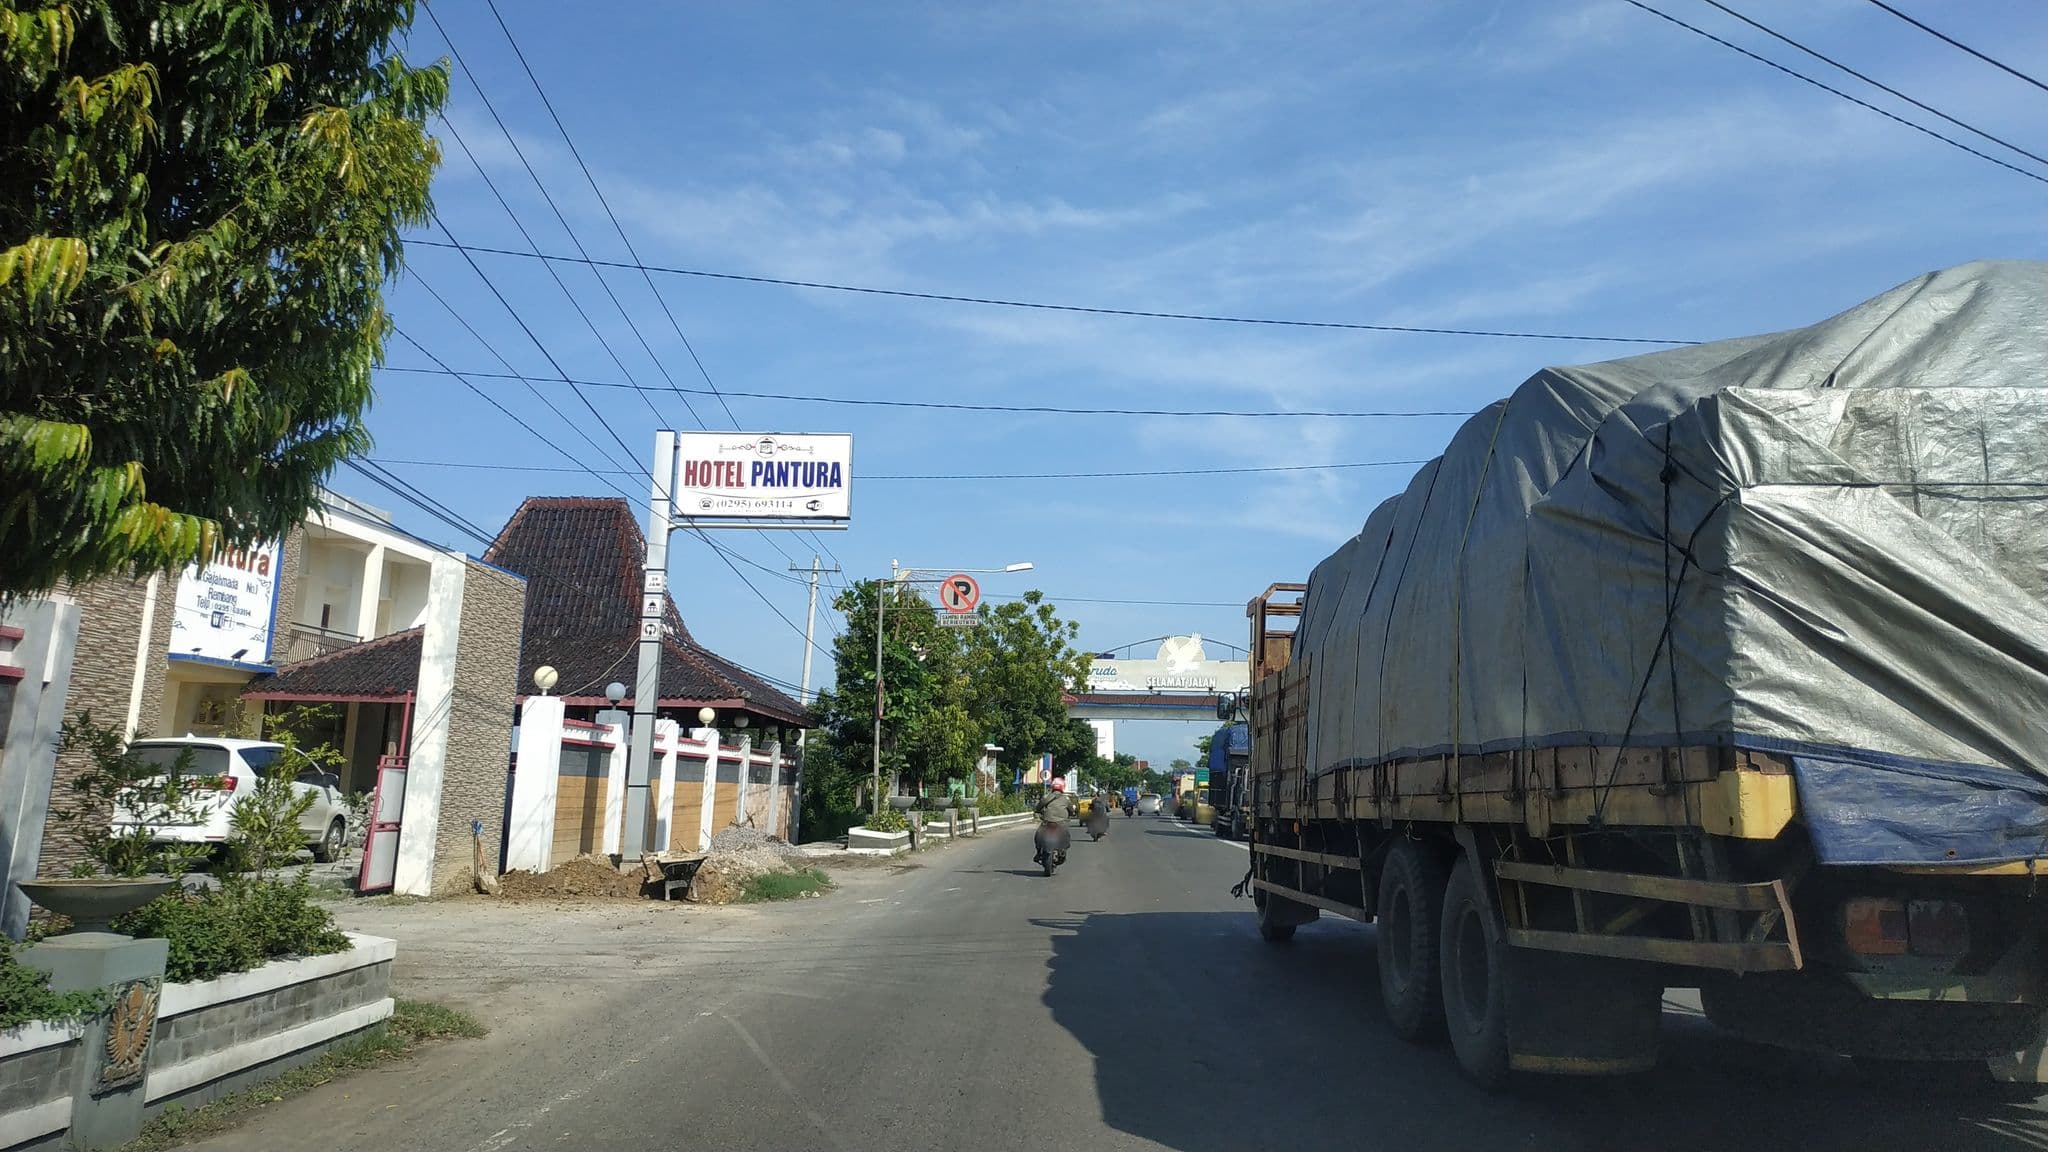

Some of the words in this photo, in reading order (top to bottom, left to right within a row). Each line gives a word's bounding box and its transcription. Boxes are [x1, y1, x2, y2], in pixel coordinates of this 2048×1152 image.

[684, 460, 745, 488] HOTEL
[751, 461, 842, 488] PANTURA
[716, 499, 751, 509] (0295)
[755, 500, 793, 509] 693114
[208, 587, 238, 606] Rembang
[953, 581, 971, 606] P
[1146, 676, 1185, 688] SELAMAT
[1187, 677, 1216, 688] JALAN
